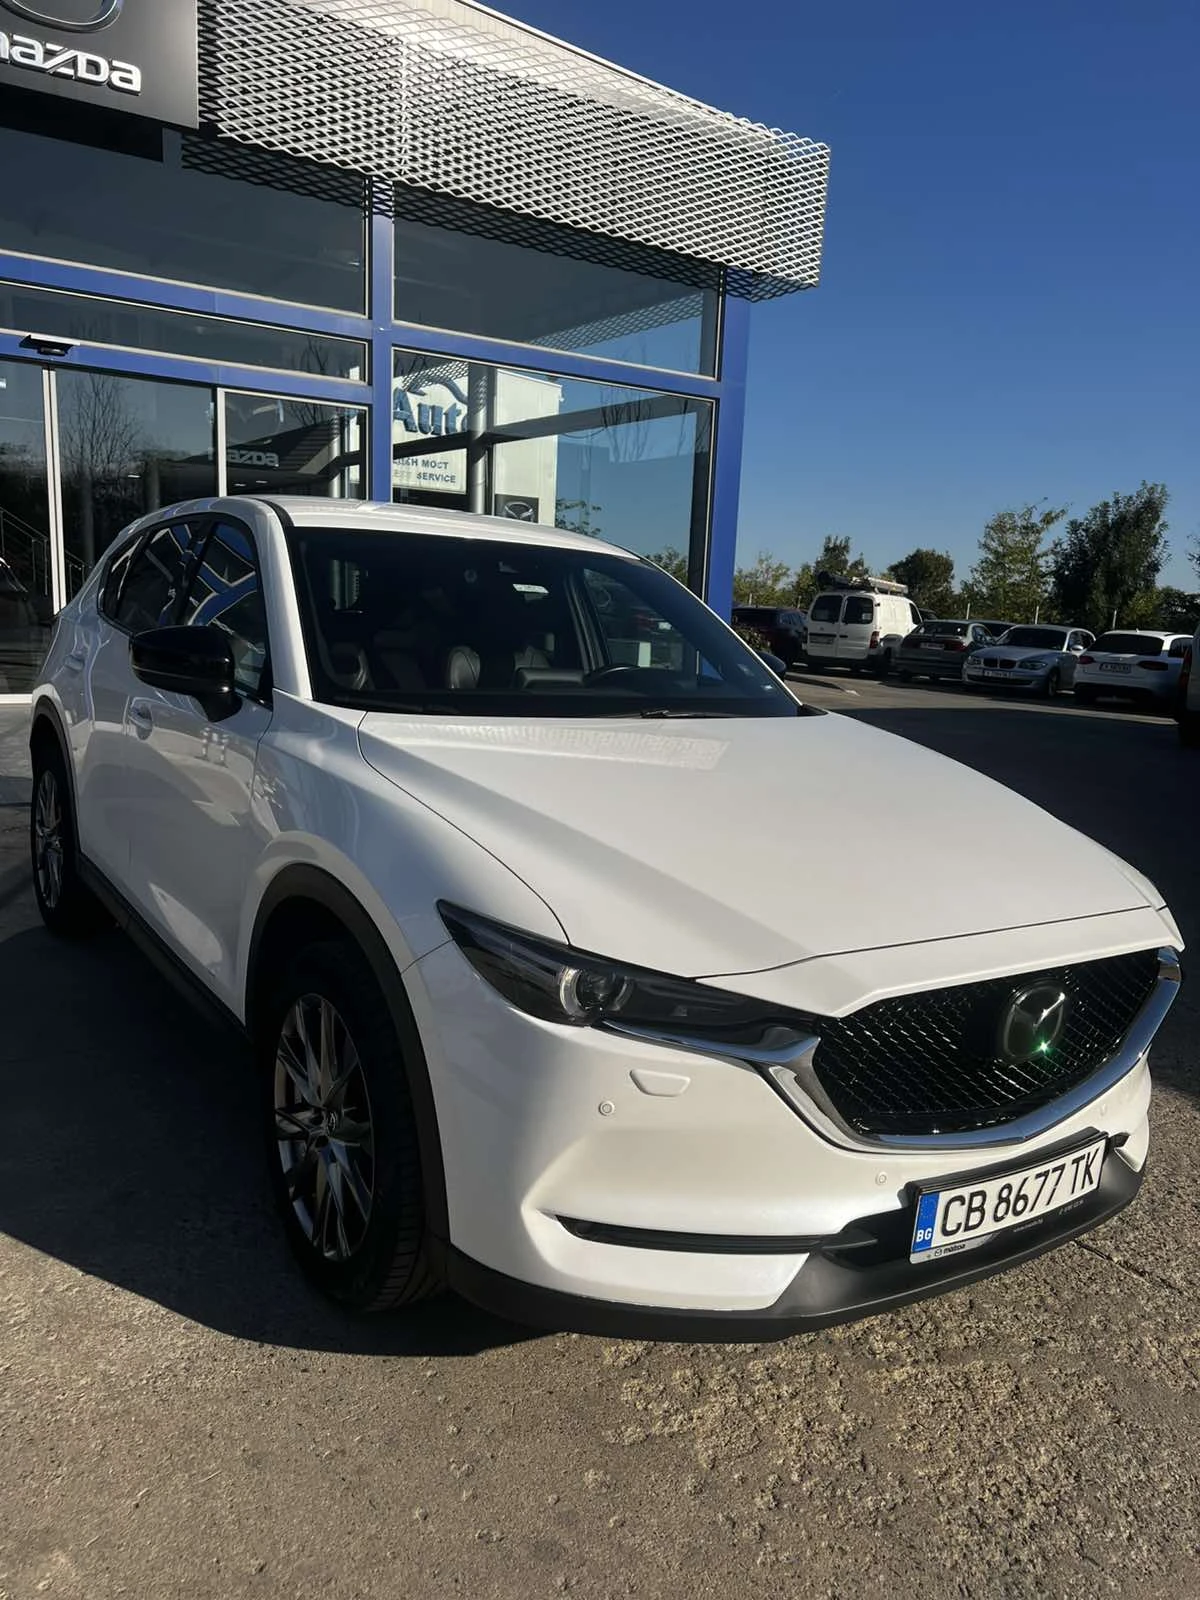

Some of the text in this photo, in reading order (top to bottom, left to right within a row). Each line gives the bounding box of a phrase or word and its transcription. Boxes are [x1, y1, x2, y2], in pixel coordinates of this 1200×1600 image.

[416, 472, 456, 484] SERVICE
[916, 1148, 1100, 1243] BG CB 8677 TK
